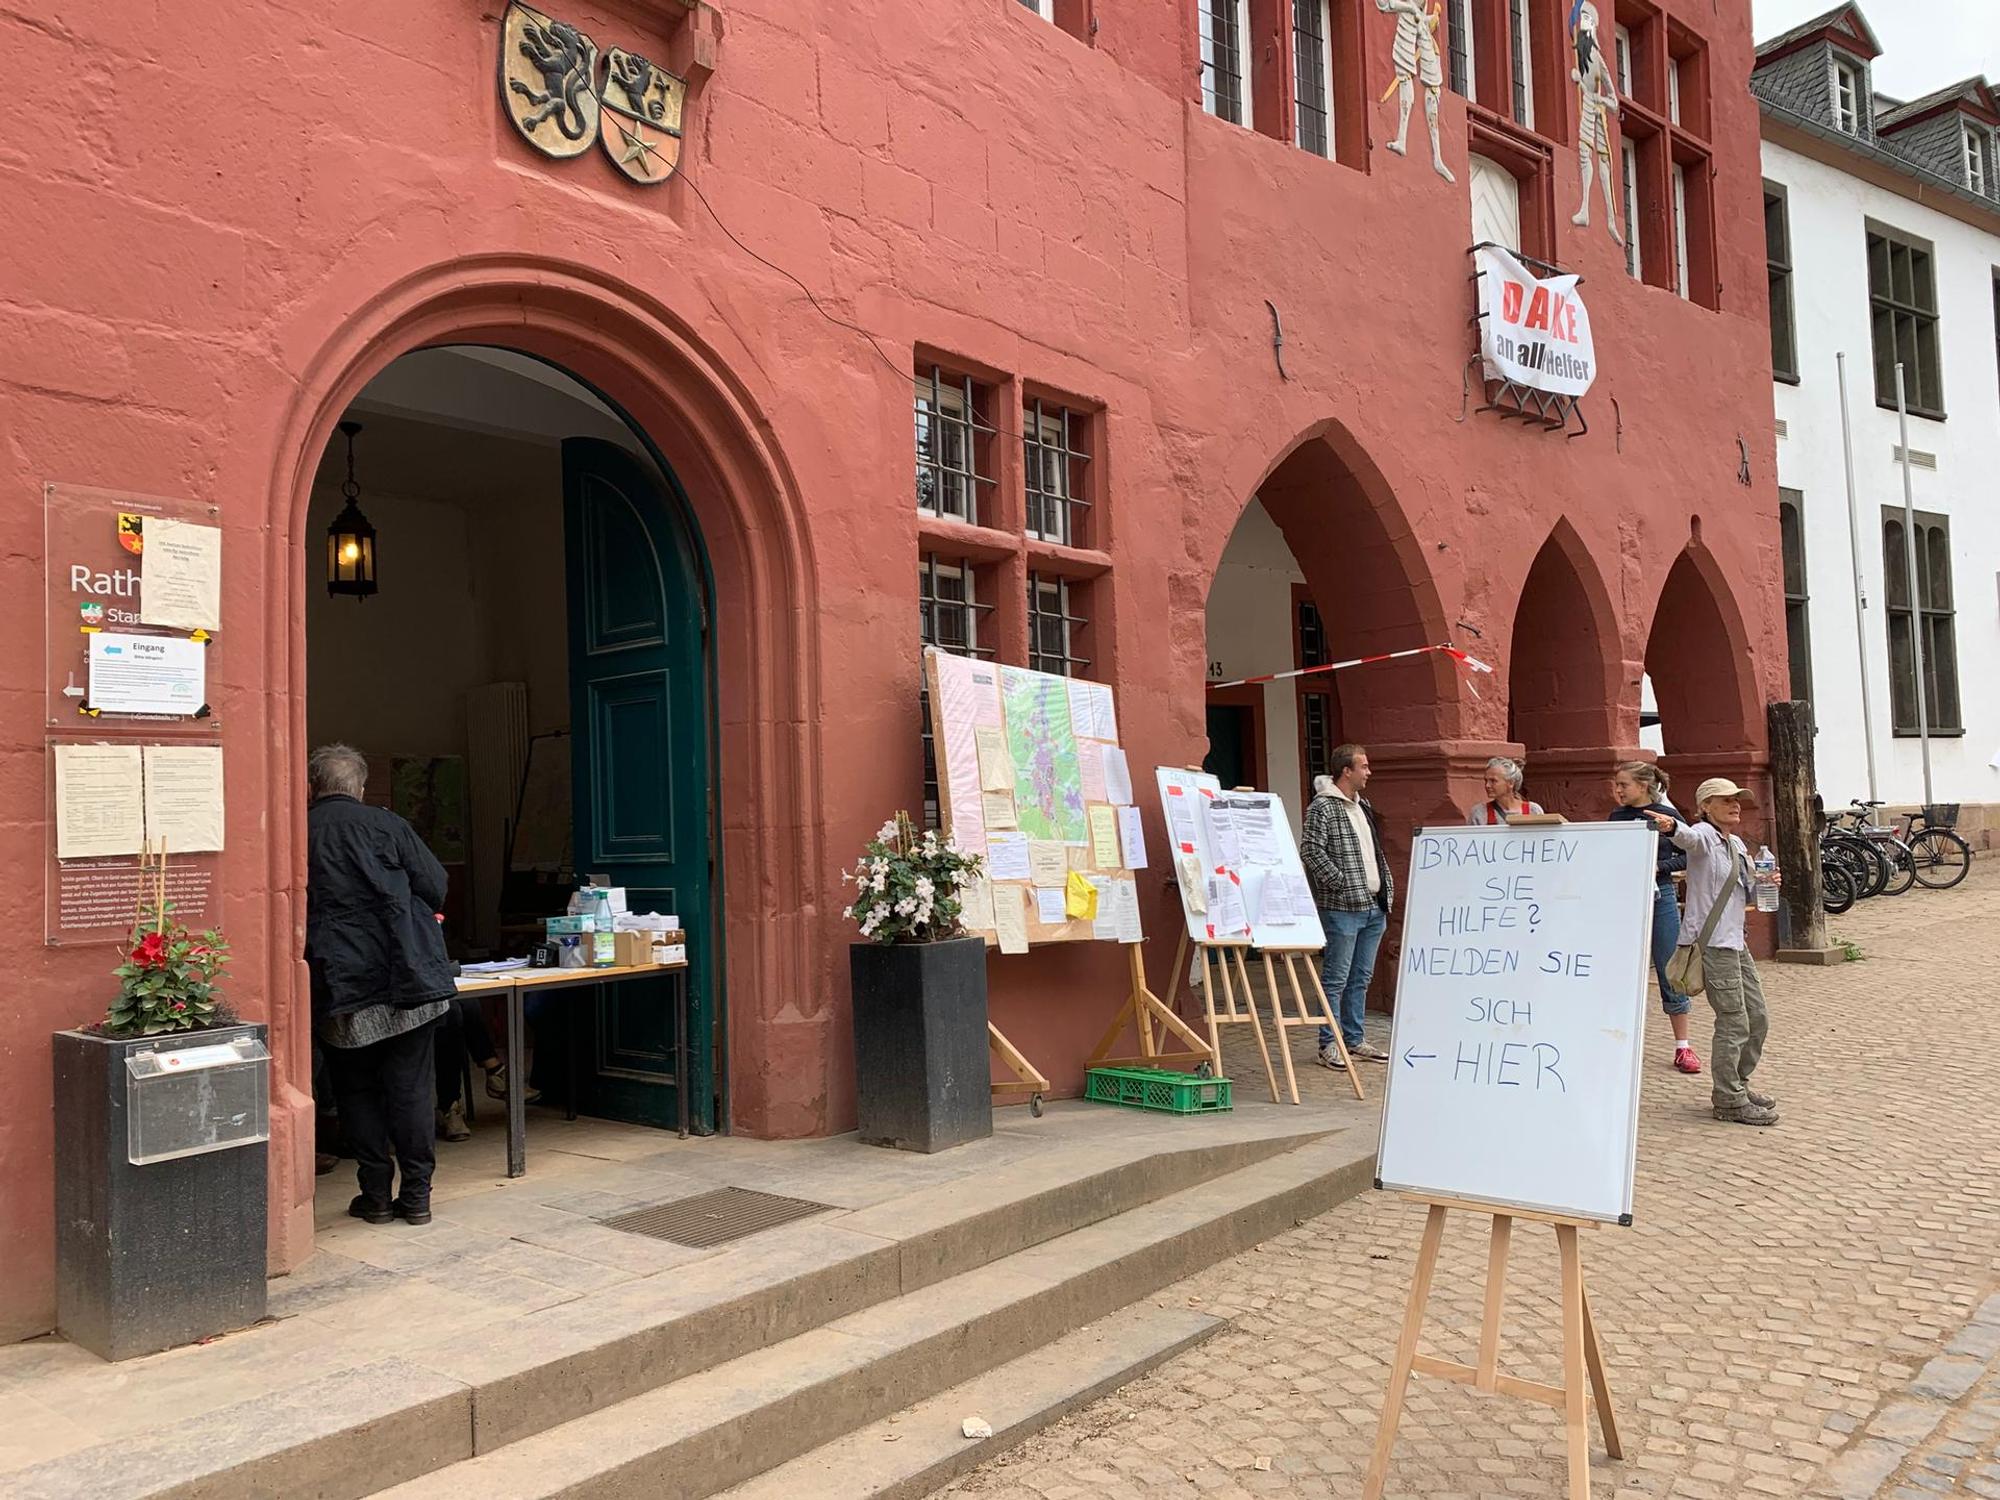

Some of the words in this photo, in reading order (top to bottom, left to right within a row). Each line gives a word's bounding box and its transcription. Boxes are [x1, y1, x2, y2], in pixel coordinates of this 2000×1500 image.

[1503, 280, 1578, 343] DAKE
[1496, 334, 1514, 361] an
[1517, 341, 1546, 370] all
[1546, 349, 1589, 381] Helfer
[132, 642, 165, 654] Eingang
[1418, 837, 1579, 870] BRAUCHEN
[1480, 875, 1534, 901] SIE
[1438, 903, 1542, 937] HILFE?
[1408, 947, 1520, 977] MELDEN
[1539, 950, 1593, 977] SIE
[1465, 997, 1532, 1025] SICH
[1454, 1040, 1566, 1093] HIER
